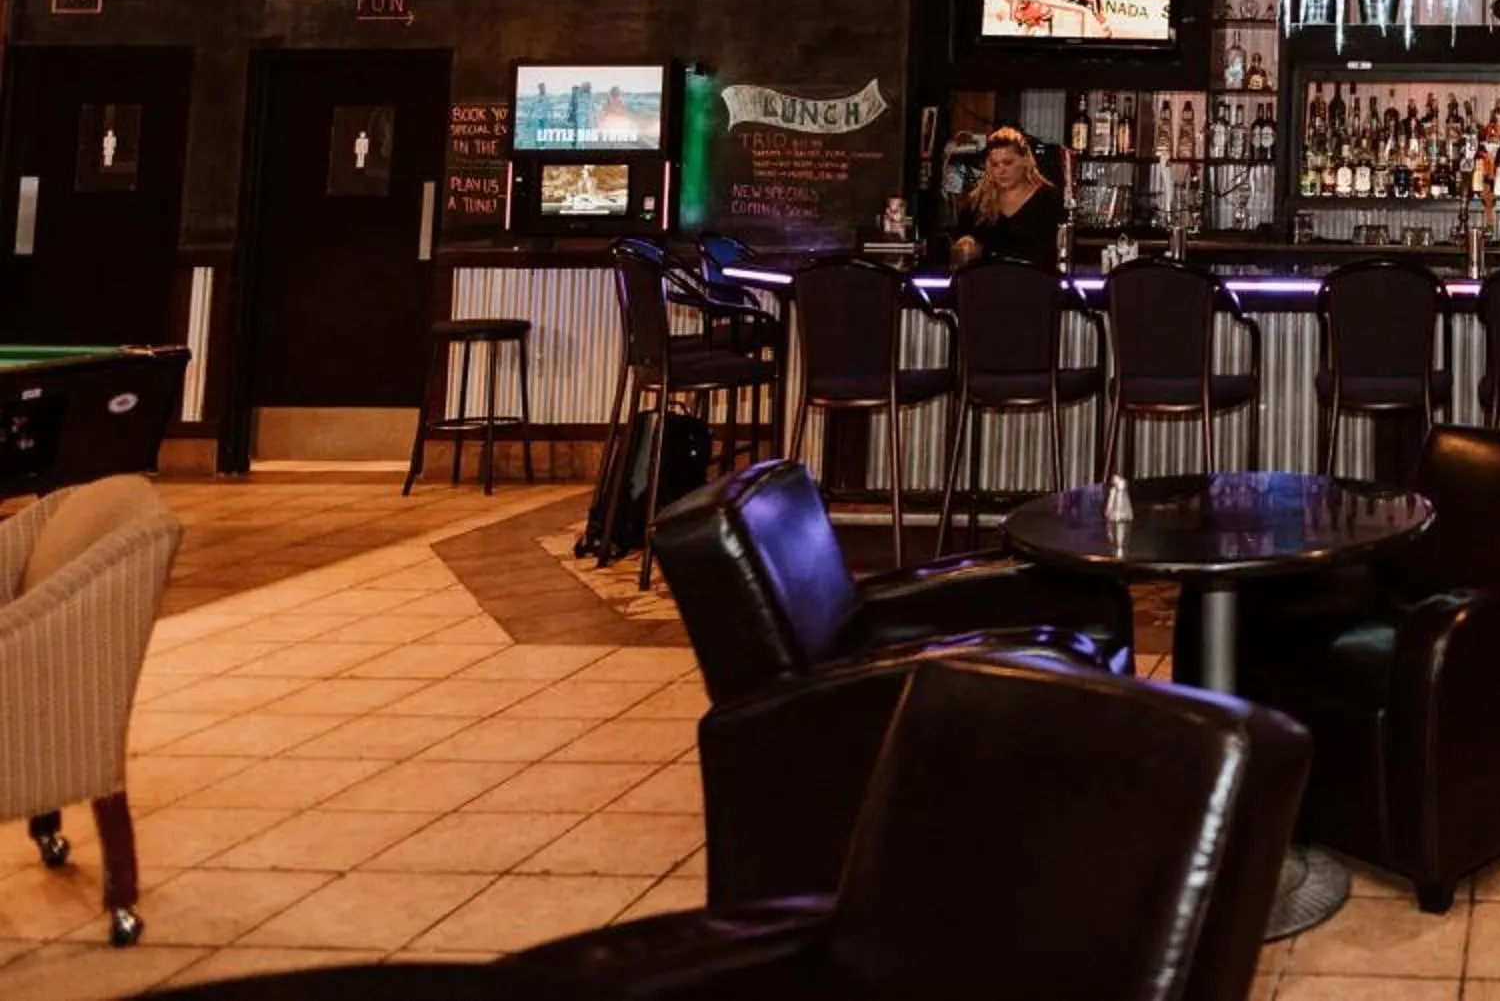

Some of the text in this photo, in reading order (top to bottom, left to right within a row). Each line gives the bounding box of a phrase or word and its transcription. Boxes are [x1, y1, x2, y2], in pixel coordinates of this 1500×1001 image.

[450, 106, 508, 122] BOOK YO
[763, 95, 860, 125] LUNCH
[449, 123, 492, 136] SPECIAL
[535, 128, 575, 142] LITTLE
[452, 139, 499, 157] IN THE
[450, 176, 499, 194] PLAY US
[732, 183, 764, 199] NEW
